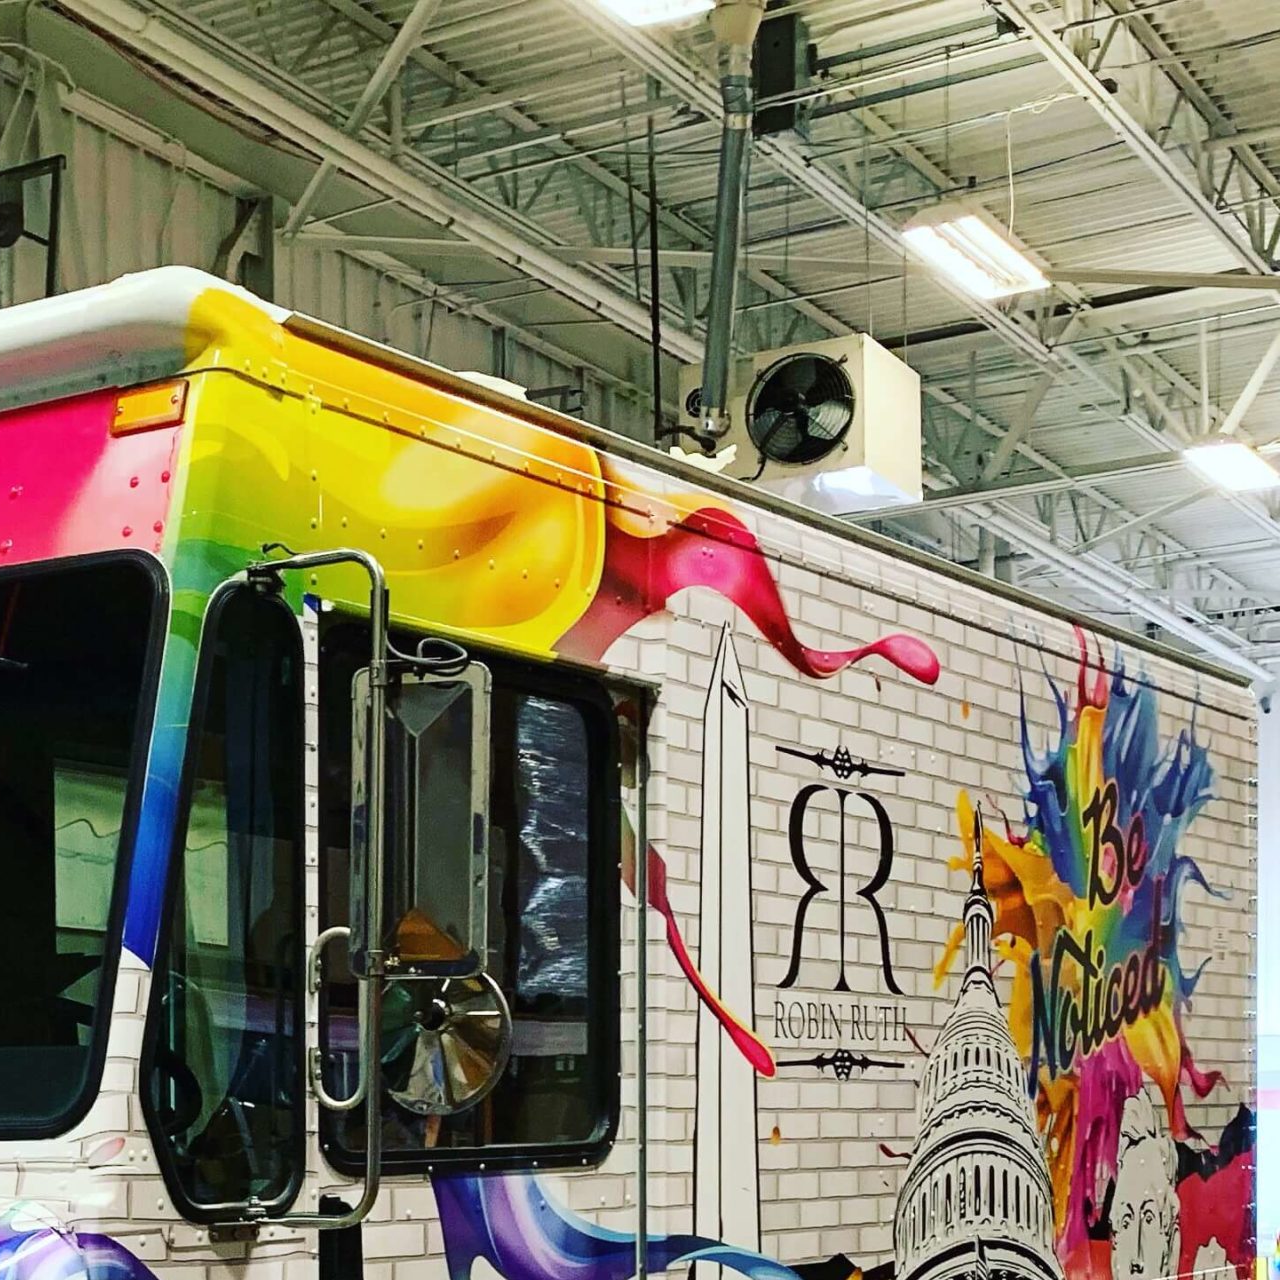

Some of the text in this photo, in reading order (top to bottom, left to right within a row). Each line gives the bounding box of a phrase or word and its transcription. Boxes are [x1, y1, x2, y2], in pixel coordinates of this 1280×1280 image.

[1083, 779, 1144, 910] Be
[773, 1001, 907, 1041] ROBIN RUTH
[1029, 876, 1165, 1099] Noticed
